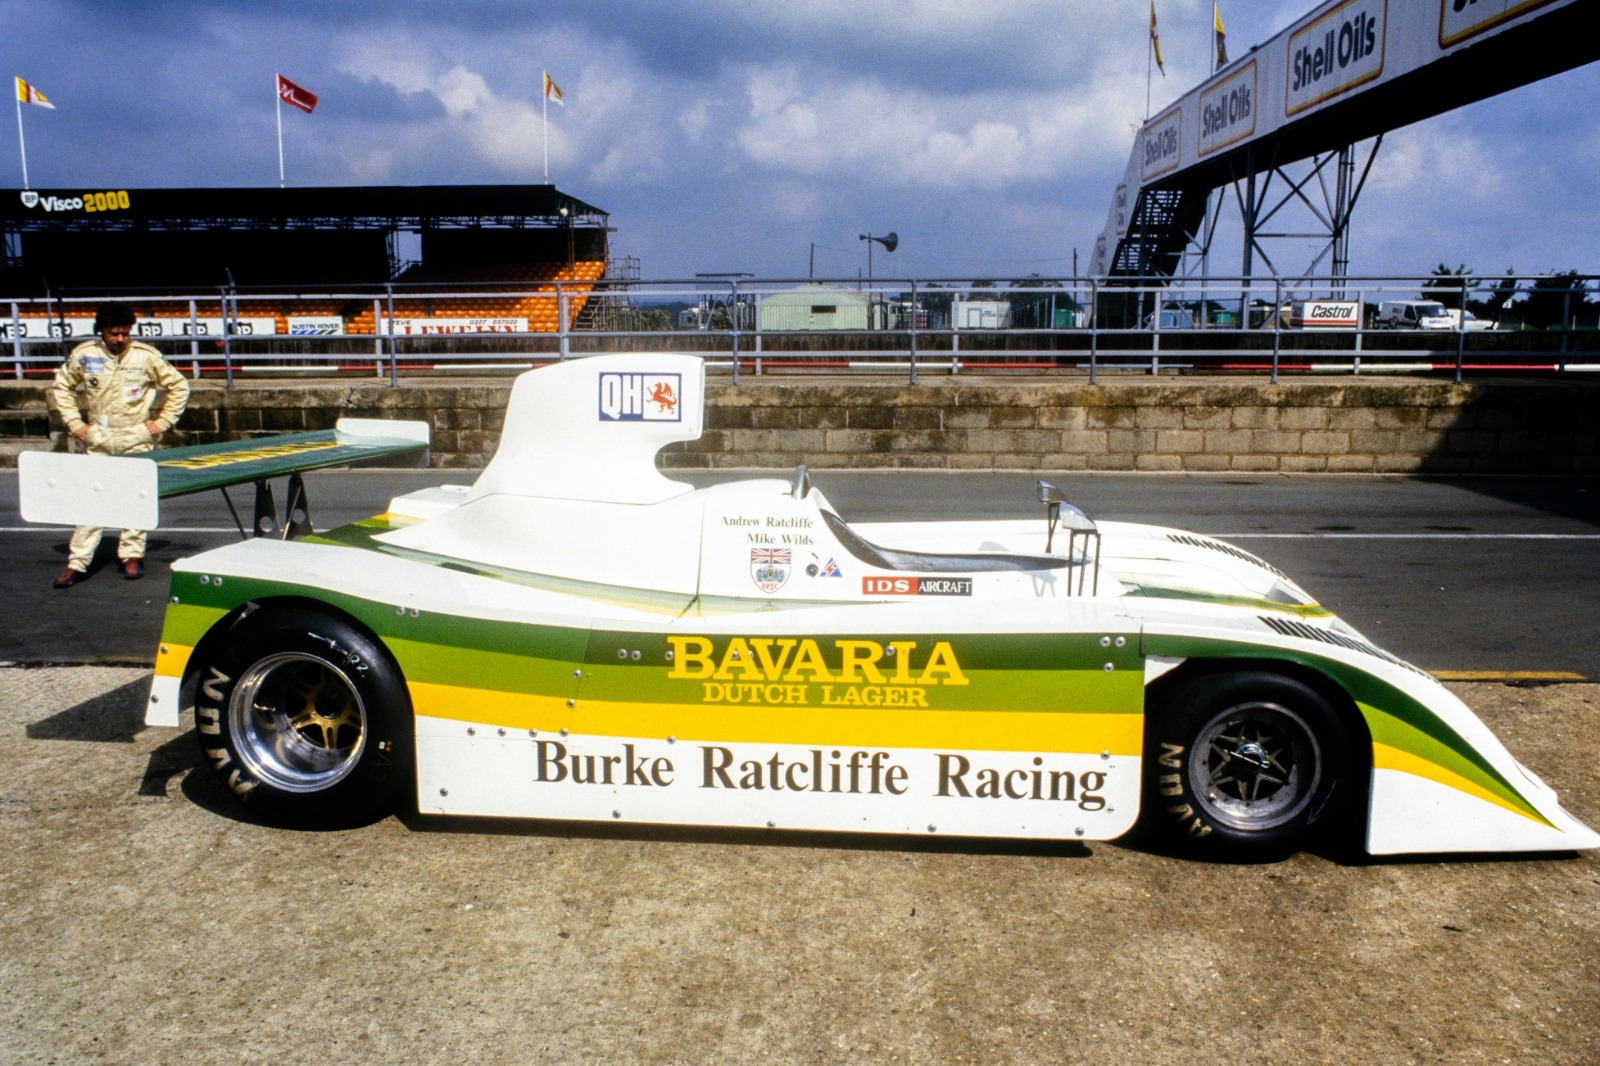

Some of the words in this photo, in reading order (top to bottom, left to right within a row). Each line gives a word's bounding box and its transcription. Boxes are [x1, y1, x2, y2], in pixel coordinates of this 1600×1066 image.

[1292, 28, 1335, 92] Shell
[1337, 11, 1376, 69] Oils
[1202, 94, 1228, 138] Shell
[1229, 83, 1251, 125] Oils
[39, 196, 83, 212] Visco
[82, 190, 130, 212] 2000
[1311, 304, 1354, 318] Castrol
[140, 324, 161, 337] BP
[387, 325, 518, 335] LEWELYN
[602, 374, 642, 420] QH
[721, 515, 761, 527] Andrew
[766, 516, 813, 529] Ratcliffe
[747, 532, 776, 544] Mike
[781, 533, 814, 545] Wilds
[867, 580, 911, 593] IDS
[918, 580, 972, 593] AIRCRAFT
[667, 636, 970, 686] BAVARIA
[702, 682, 808, 704] DUTCH
[821, 685, 929, 707] LAGER
[532, 739, 675, 787] Burke
[697, 746, 909, 796] Ratcliffe
[932, 753, 1108, 812] Racing
